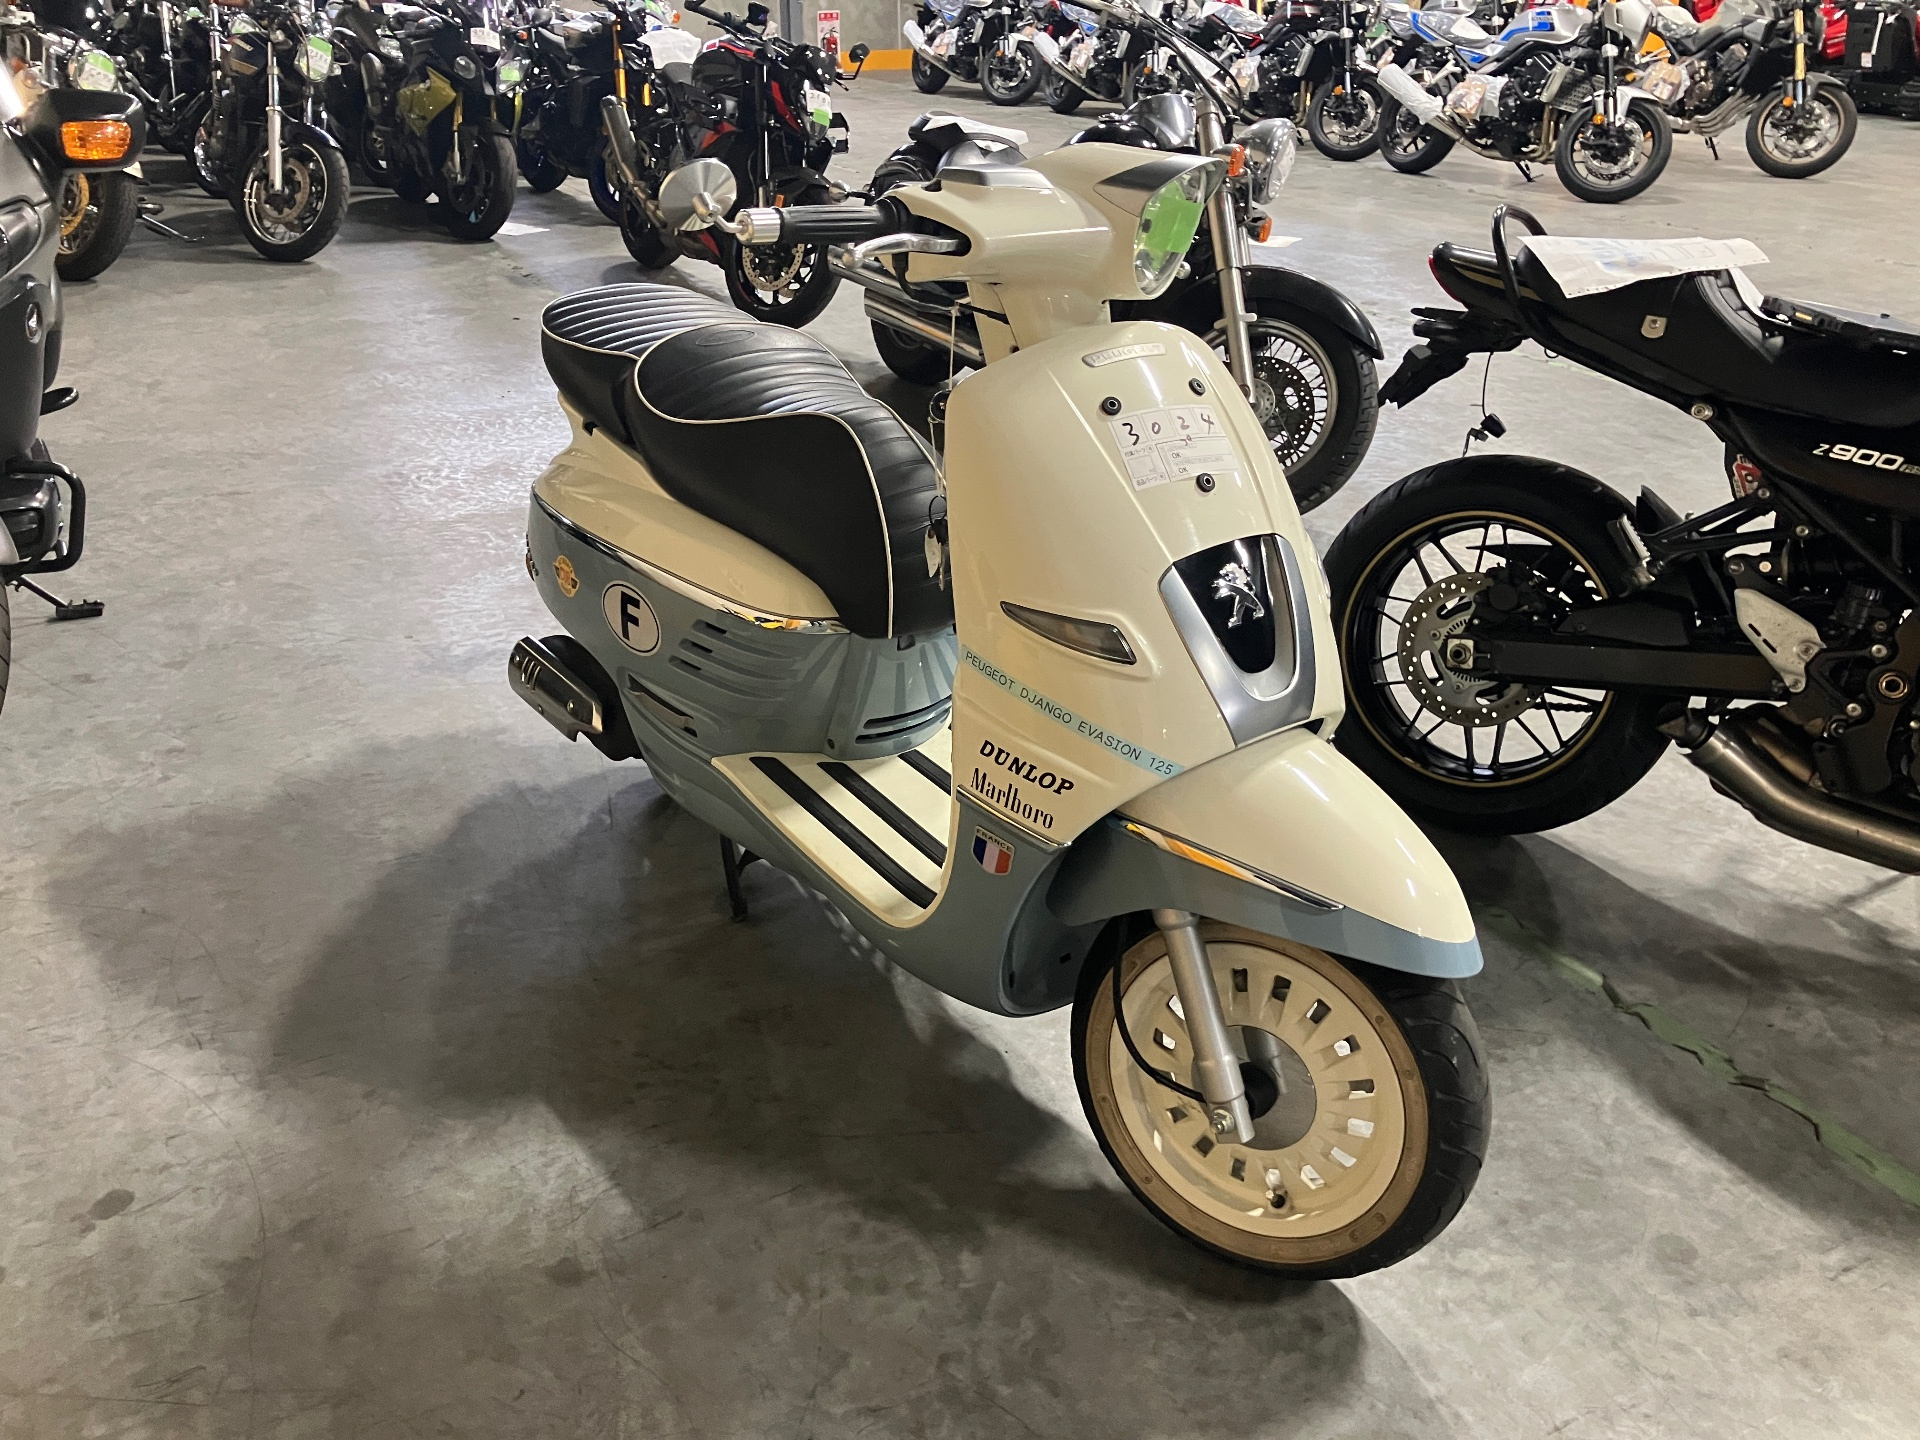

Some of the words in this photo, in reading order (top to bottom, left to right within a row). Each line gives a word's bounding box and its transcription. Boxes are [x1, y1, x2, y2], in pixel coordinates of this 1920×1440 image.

[1089, 344, 1161, 364] PEUGEOT
[1121, 412, 1215, 446] 3024
[1178, 466, 1189, 474] OK
[620, 590, 641, 642] F
[965, 651, 1016, 690] PEUGEOT
[1020, 687, 1073, 724] DJANGO
[1077, 720, 1142, 761] EVASION
[1149, 757, 1173, 775] 125
[979, 739, 1075, 796] DUNLOP
[970, 767, 1054, 829] Marlboro
[976, 828, 1012, 851] FRANCE
